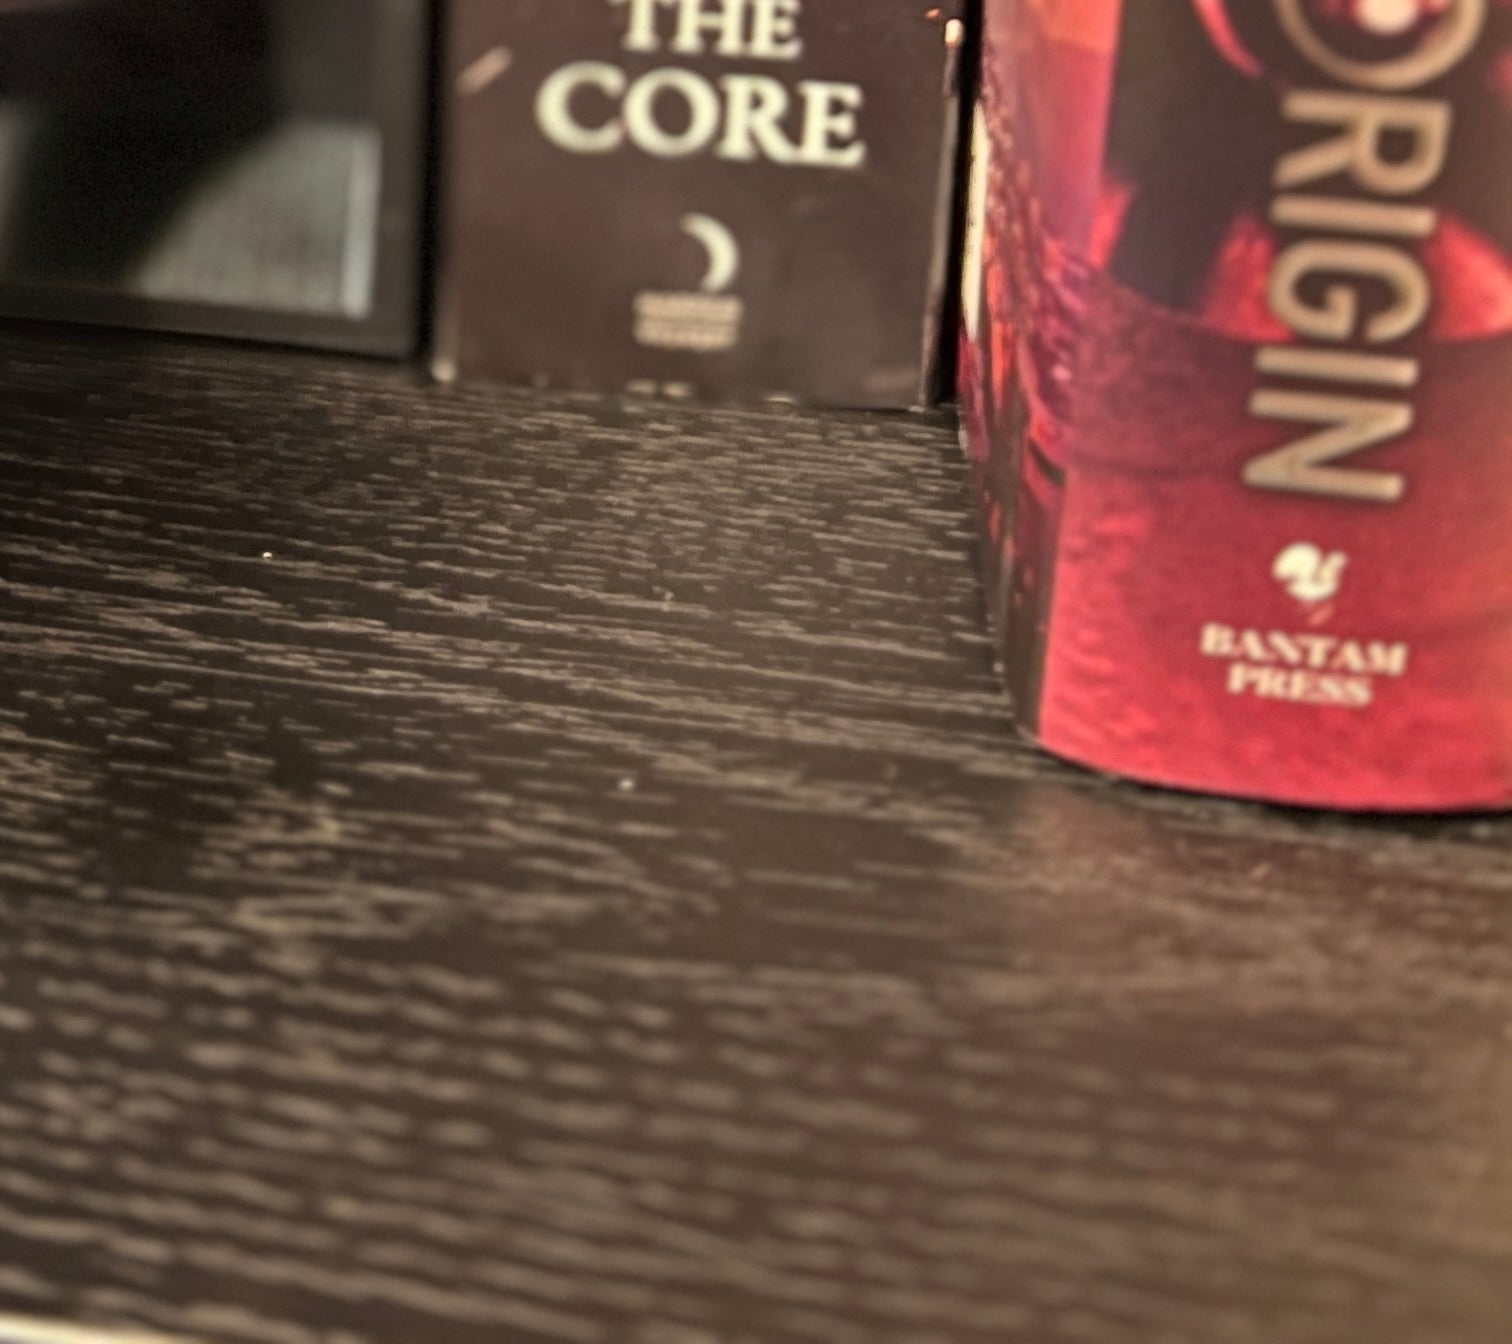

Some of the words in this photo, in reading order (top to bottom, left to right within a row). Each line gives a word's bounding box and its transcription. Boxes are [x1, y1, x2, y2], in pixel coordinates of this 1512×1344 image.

[534, 59, 867, 169] CORE
[1199, 621, 1409, 676] BANTAM
[1226, 658, 1372, 708] PRESS
